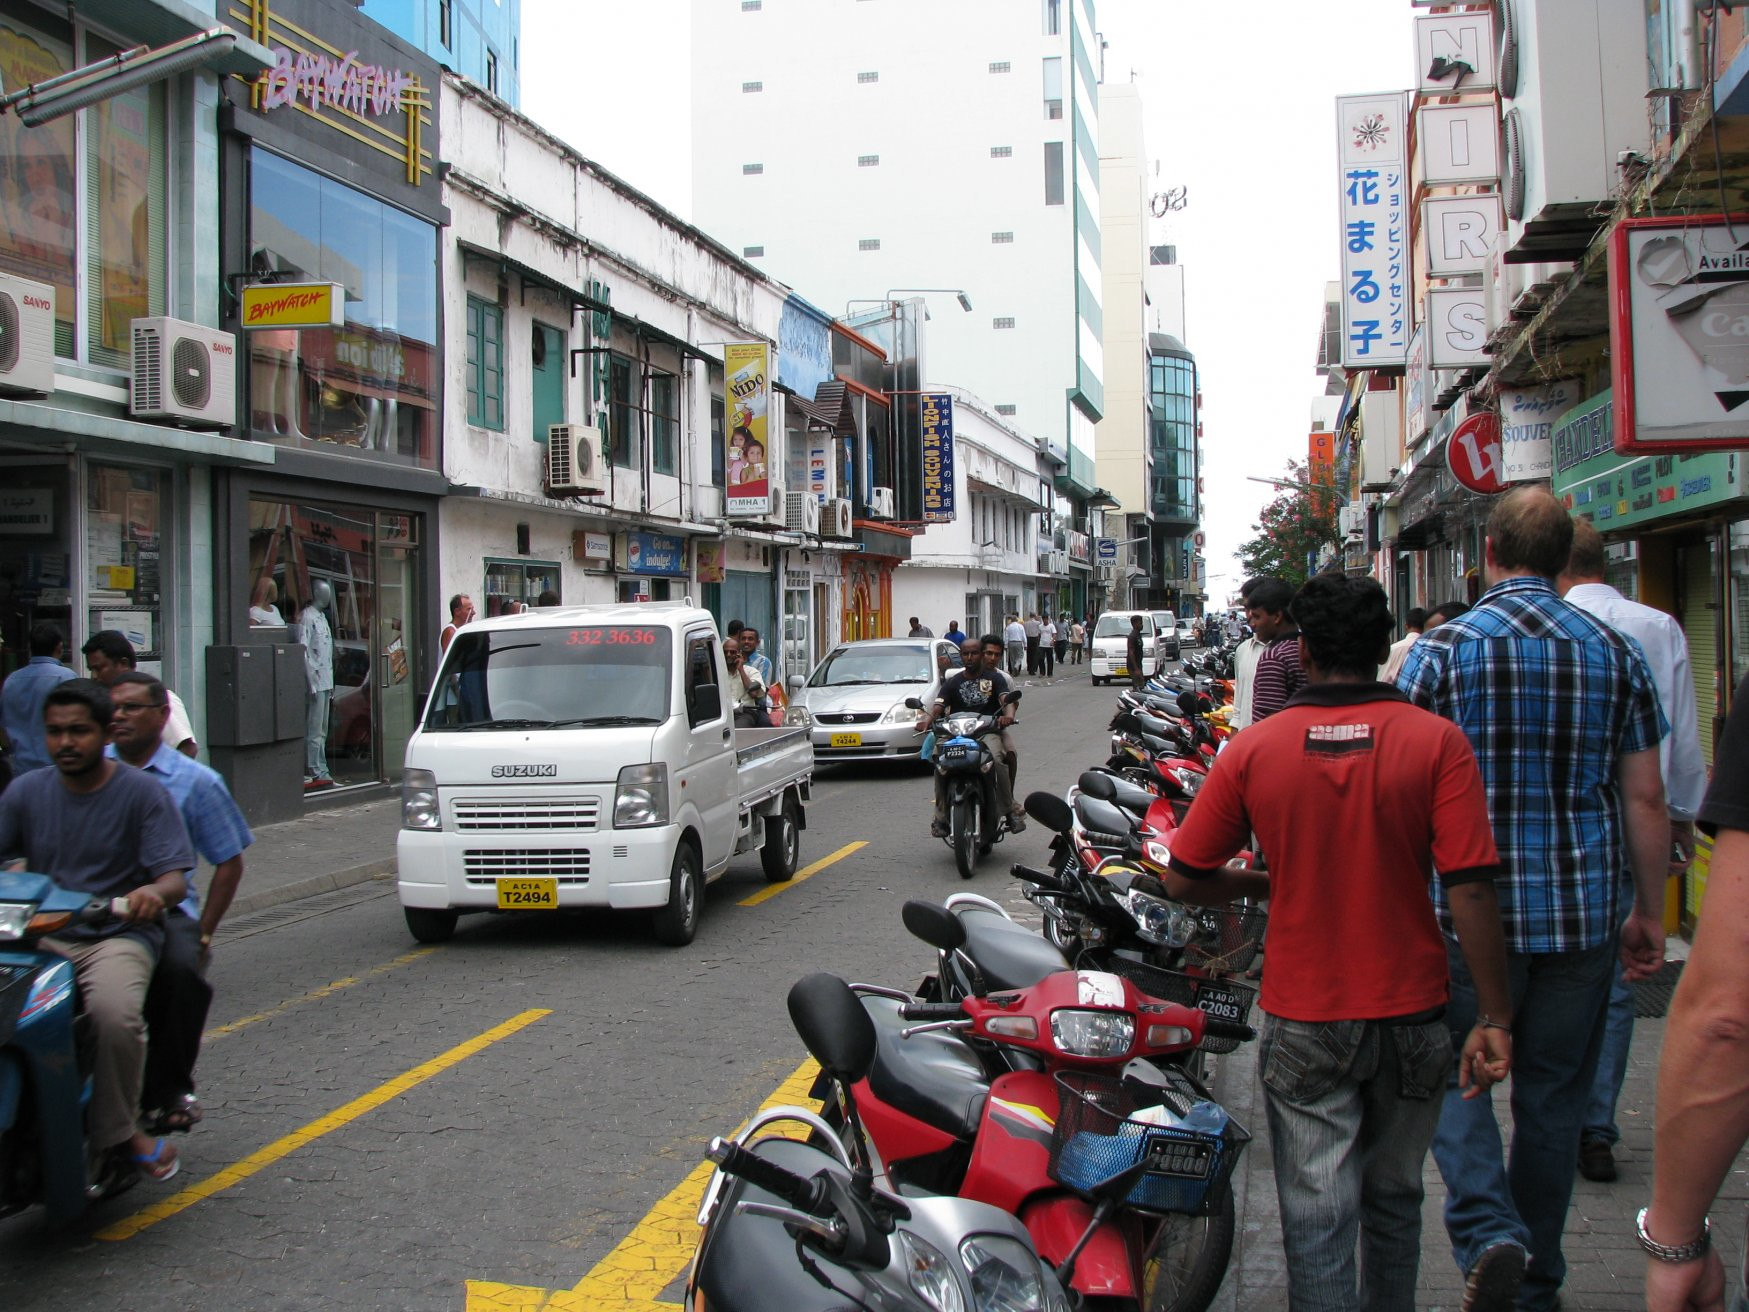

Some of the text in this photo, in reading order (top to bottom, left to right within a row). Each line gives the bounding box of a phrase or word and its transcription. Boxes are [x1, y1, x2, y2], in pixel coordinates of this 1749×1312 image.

[263, 48, 413, 119] BAYWATCH
[1345, 169, 1383, 355] 花まる子
[1386, 172, 1403, 347] ショッピングセンター
[23, 295, 51, 310] SANYO
[248, 291, 326, 321] BAYWATCH
[212, 342, 233, 355] SANYO
[730, 373, 764, 398] NIDO
[941, 397, 952, 508] 竹中直人さんのお店
[924, 449, 942, 508] SOUVENIRS
[653, 537, 662, 549] Go
[646, 553, 671, 570] indulge!
[1098, 559, 1117, 567] ASHA
[566, 629, 655, 645] 332 3636
[491, 764, 557, 777] SUZUKI
[503, 891, 551, 903] T2494
[1198, 999, 1239, 1018] C2083
